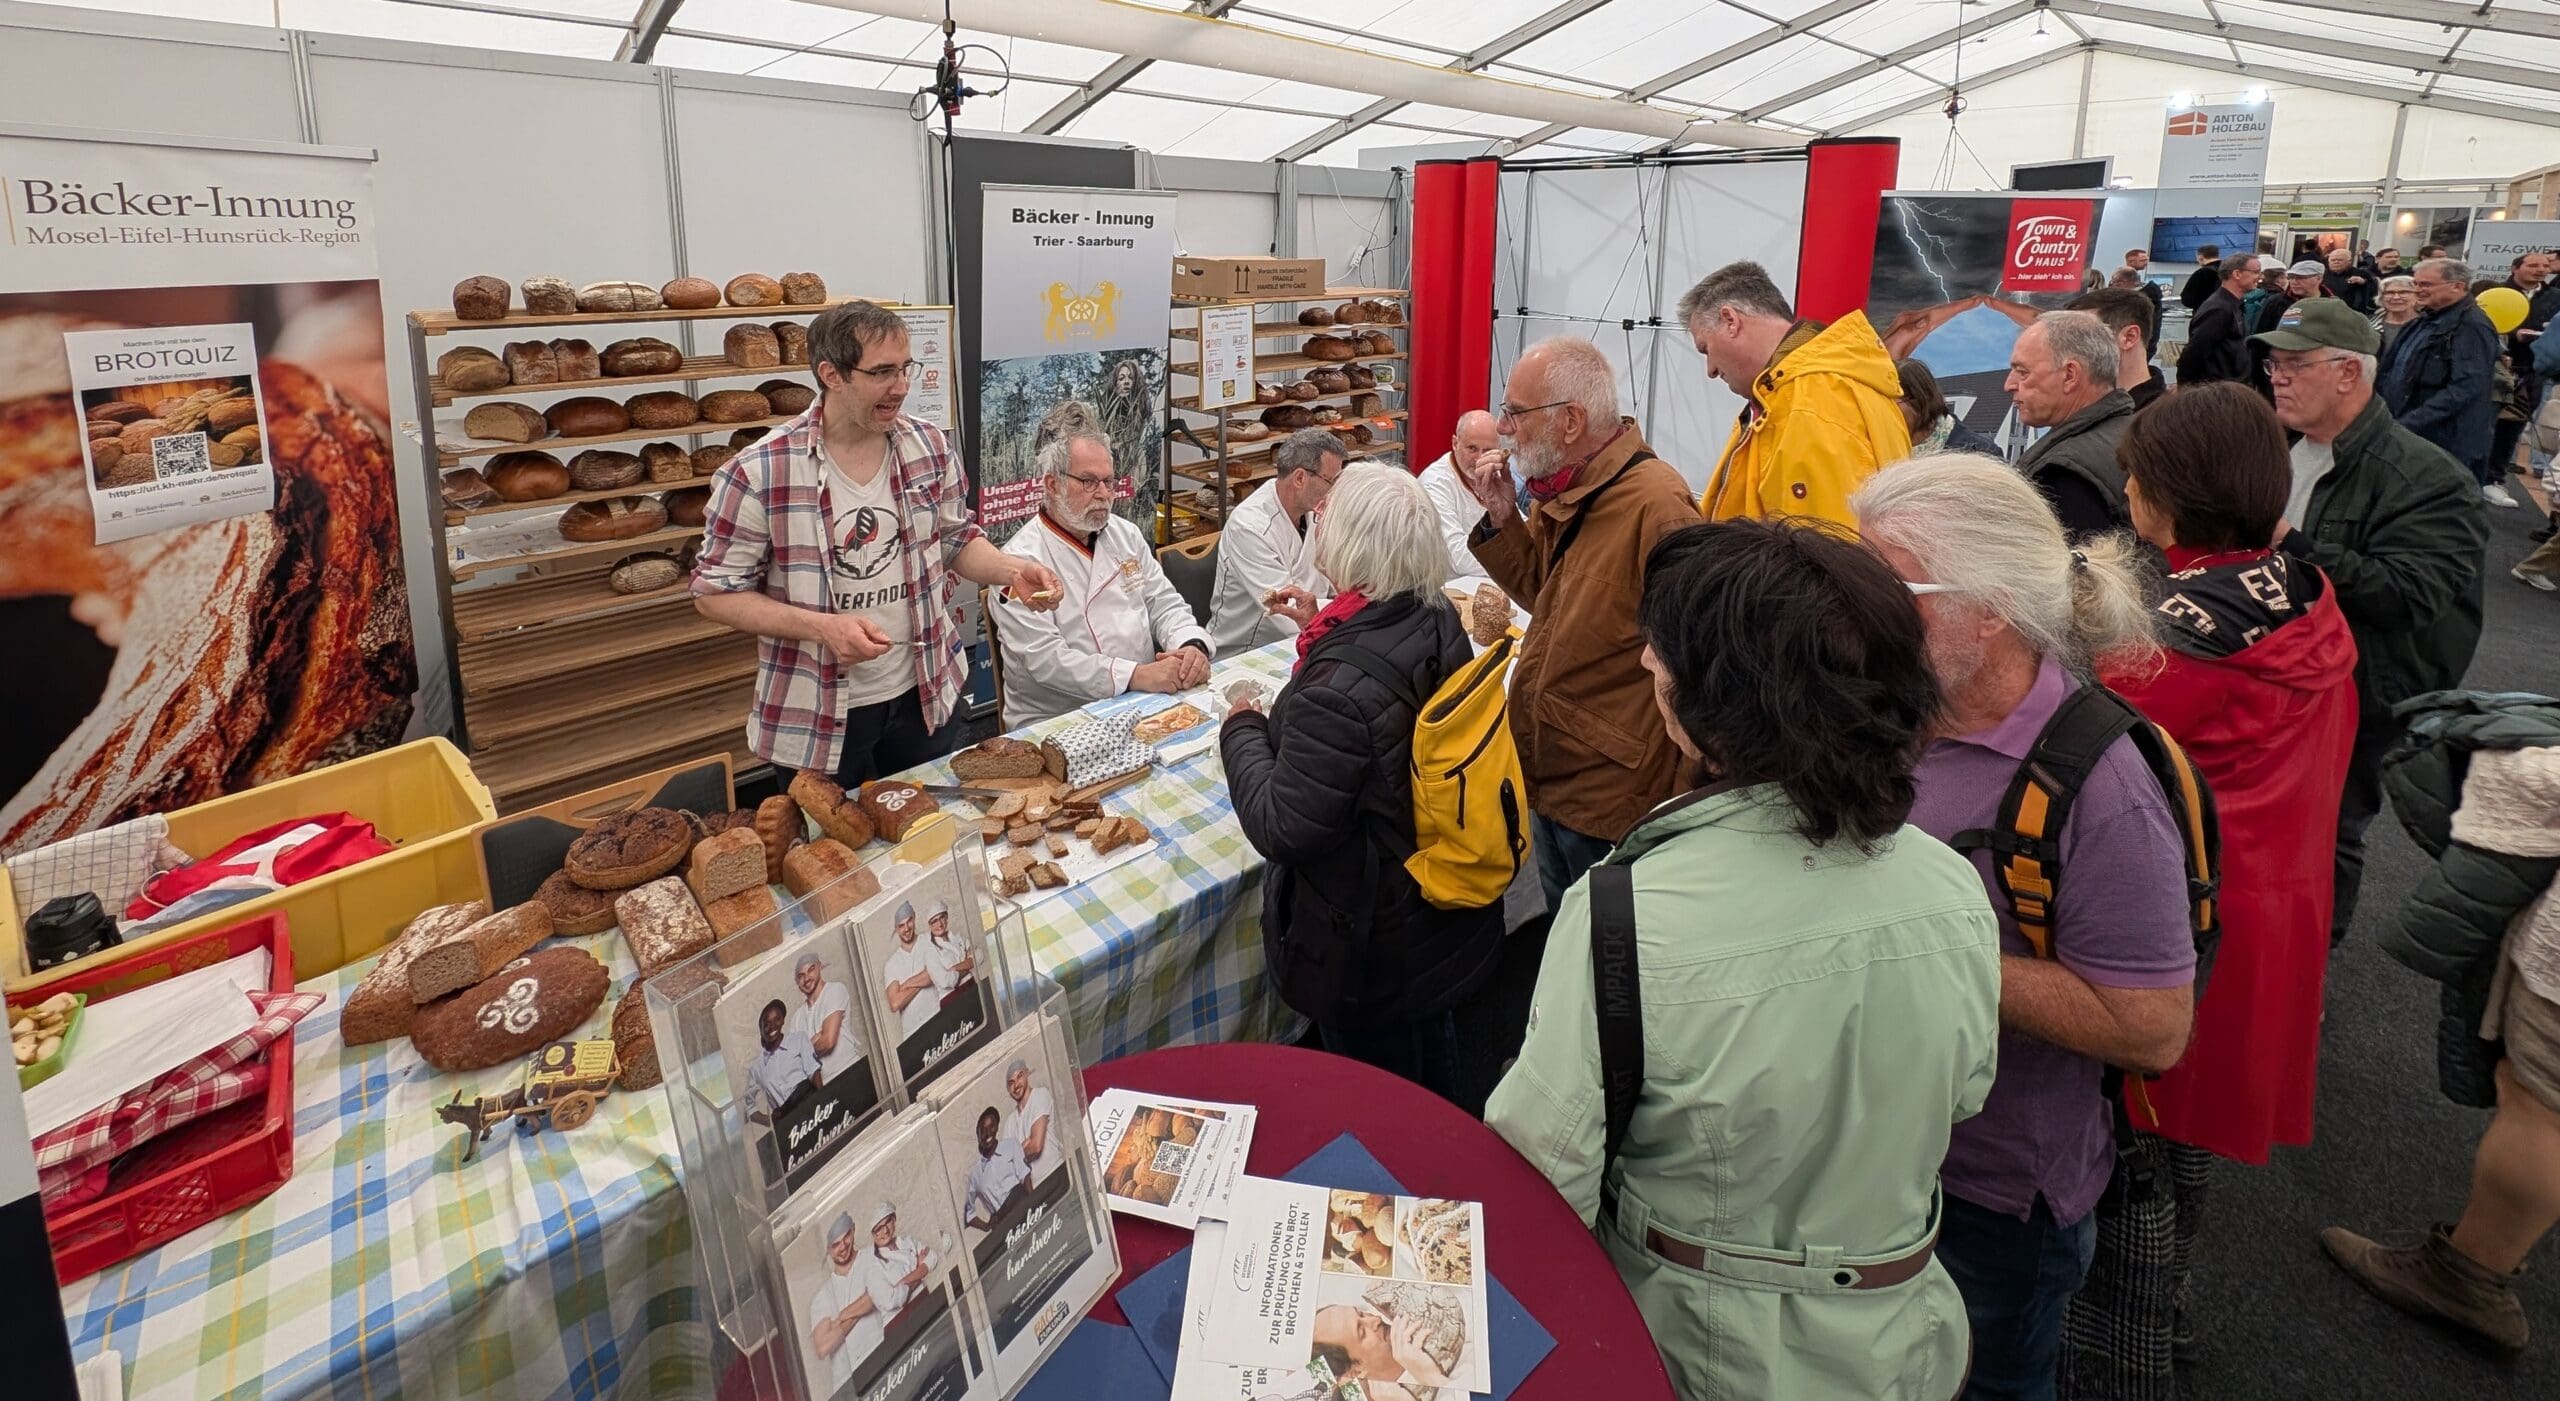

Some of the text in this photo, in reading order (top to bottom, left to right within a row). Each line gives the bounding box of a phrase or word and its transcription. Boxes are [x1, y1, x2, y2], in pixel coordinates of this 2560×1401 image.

[2212, 122, 2266, 133] HOLZBAU
[2213, 113, 2254, 124] ANTON
[18, 179, 356, 228] Bäcker-Innung
[1012, 208, 1080, 224] Bäcker
[1096, 210, 1154, 228] Innung
[2016, 215, 2077, 241] Town &
[26, 226, 361, 247] Mosel-Eifel-Hunsrück-Region
[1033, 236, 1065, 246] Trier
[1077, 236, 1134, 248] Saarburg
[2482, 244, 2560, 254] TRAGWE
[2014, 236, 2081, 268] Country
[2035, 257, 2066, 266] HAUS
[95, 346, 238, 372] BROTQUIZ
[984, 481, 1028, 496] Unser
[984, 496, 1020, 510] ohne
[984, 505, 1040, 524] Frühstü
[835, 582, 908, 610] ERFOOD
[1089, 1108, 1125, 1164] OTQUIZ
[1260, 1222, 1283, 1317] INFORMATIONEN
[1270, 1202, 1300, 1344] ZUR PRÜFUNG VON BROT,
[1285, 1212, 1310, 1335] BRÖTCHEN & STOLLEN
[1038, 1305, 1070, 1344] ZUKUNFT
[864, 1344, 930, 1401] äcker/in
[1241, 1370, 1252, 1396] ZUR
